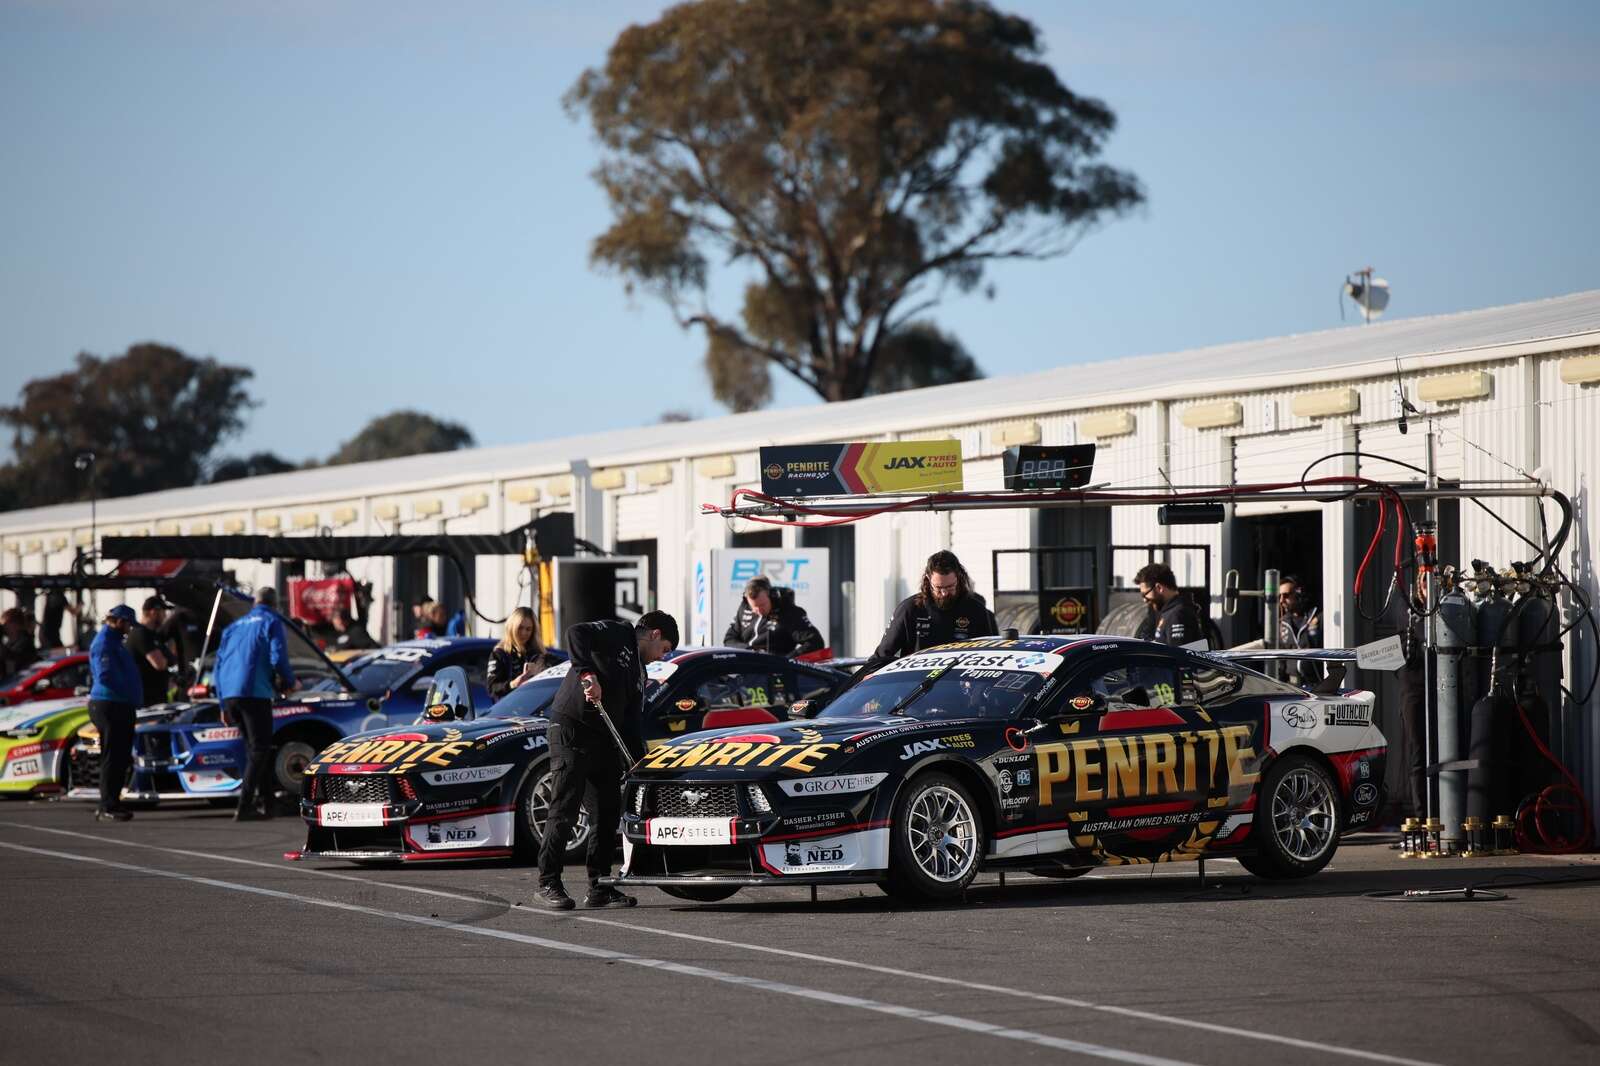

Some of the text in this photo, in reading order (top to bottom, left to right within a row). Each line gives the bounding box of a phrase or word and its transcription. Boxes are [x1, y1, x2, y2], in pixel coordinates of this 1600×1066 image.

[787, 461, 830, 471] PENRITE
[884, 456, 926, 470] JAX
[730, 559, 809, 581] BRT
[1051, 606, 1086, 615] PENRITE
[886, 653, 1014, 671] Steadfast
[960, 668, 1004, 679] Payne
[747, 687, 768, 705] 26
[523, 735, 549, 750] JA
[856, 729, 898, 748] AUSTRALIAN
[941, 733, 972, 744] TYRES
[319, 741, 474, 767] PENRITE
[900, 738, 947, 760] JAX
[643, 742, 842, 773] PENRITE
[998, 755, 1031, 764] DUNLOP
[1034, 725, 1262, 807] PENRITE
[442, 770, 486, 782] GROVE
[804, 775, 874, 793] GROVE HIRE
[326, 812, 348, 822] APEX
[784, 816, 813, 825] DASHER
[817, 812, 846, 820] FISHER
[1081, 819, 1132, 833] AUSTRALIAN
[1133, 816, 1162, 826] OWNED
[1163, 813, 1190, 825] SINCE
[446, 830, 477, 841] NED
[657, 827, 723, 839] APEX STEEL
[807, 849, 844, 862] NED
